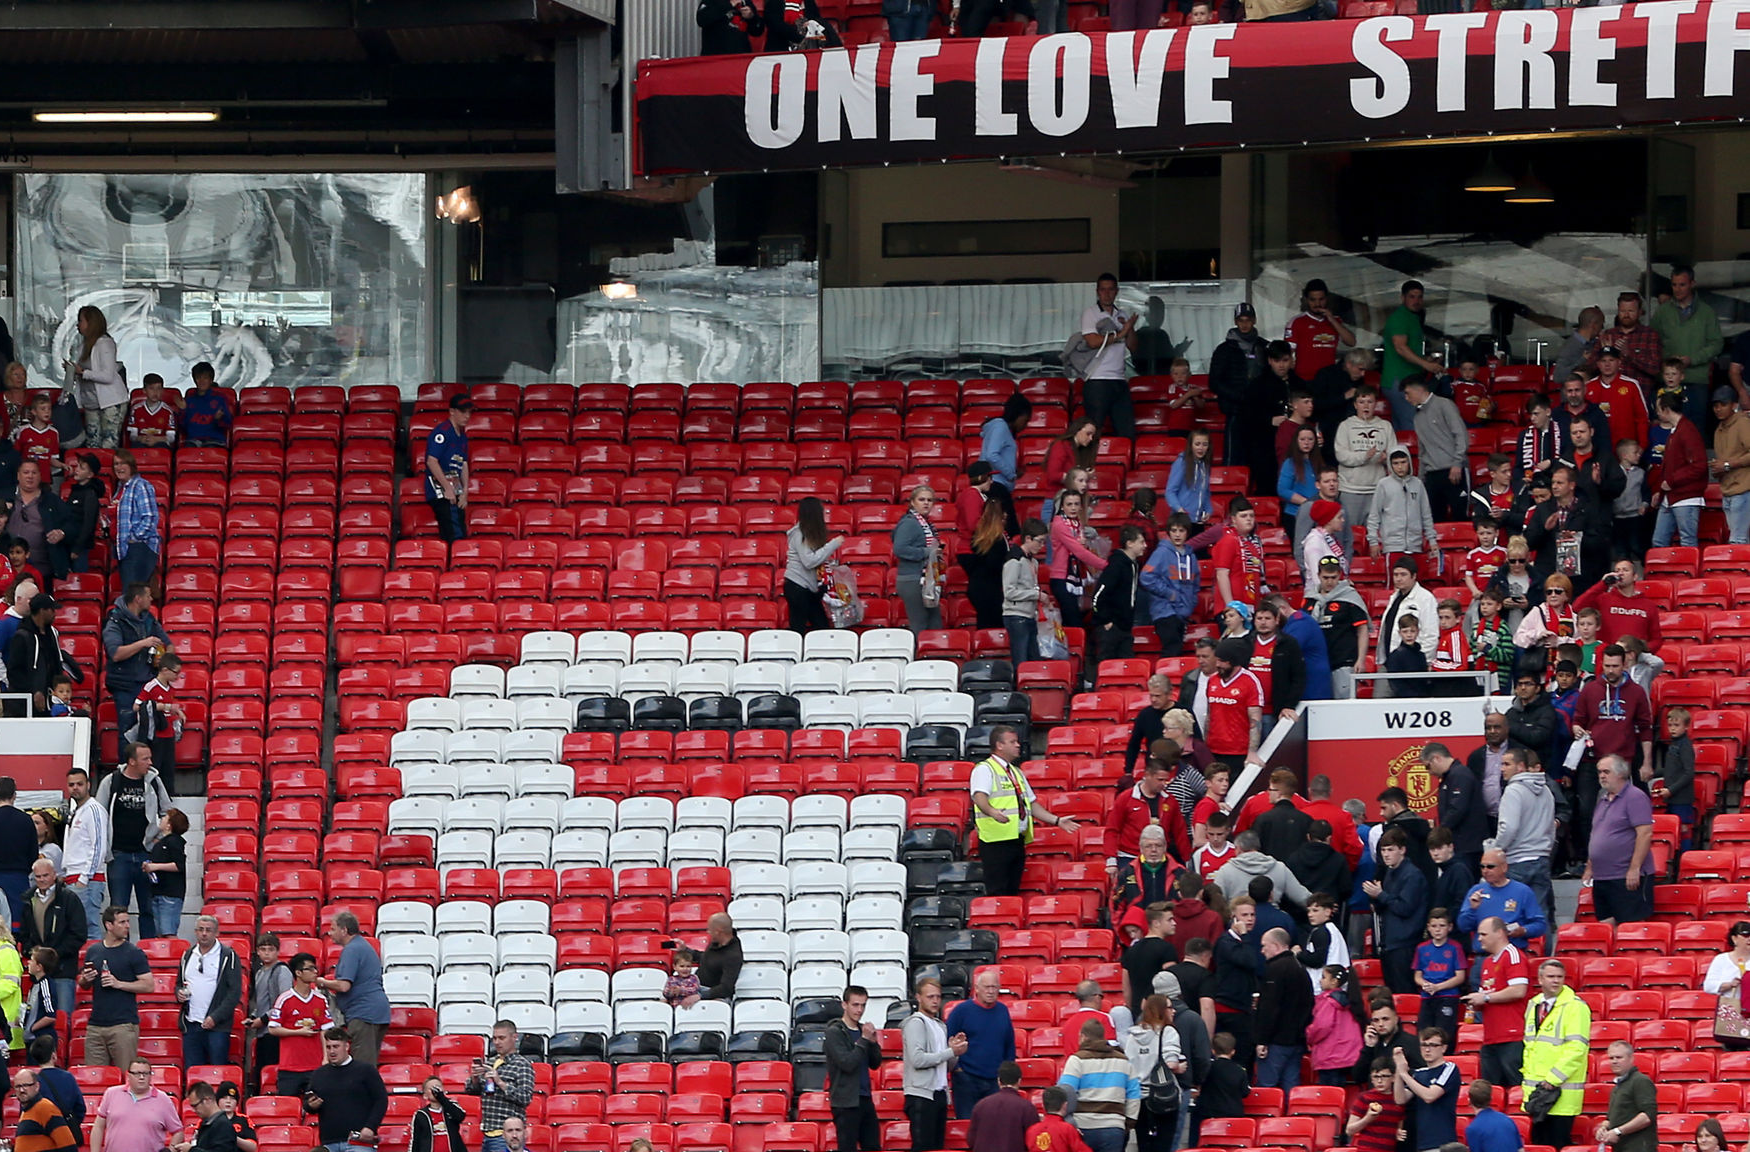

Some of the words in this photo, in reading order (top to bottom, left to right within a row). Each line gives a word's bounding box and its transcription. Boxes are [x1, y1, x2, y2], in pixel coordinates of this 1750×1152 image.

[745, 40, 941, 148] ONE
[976, 25, 1237, 136] LOVE
[1385, 711, 1452, 730] W208
[1408, 795, 1439, 810] NITED
